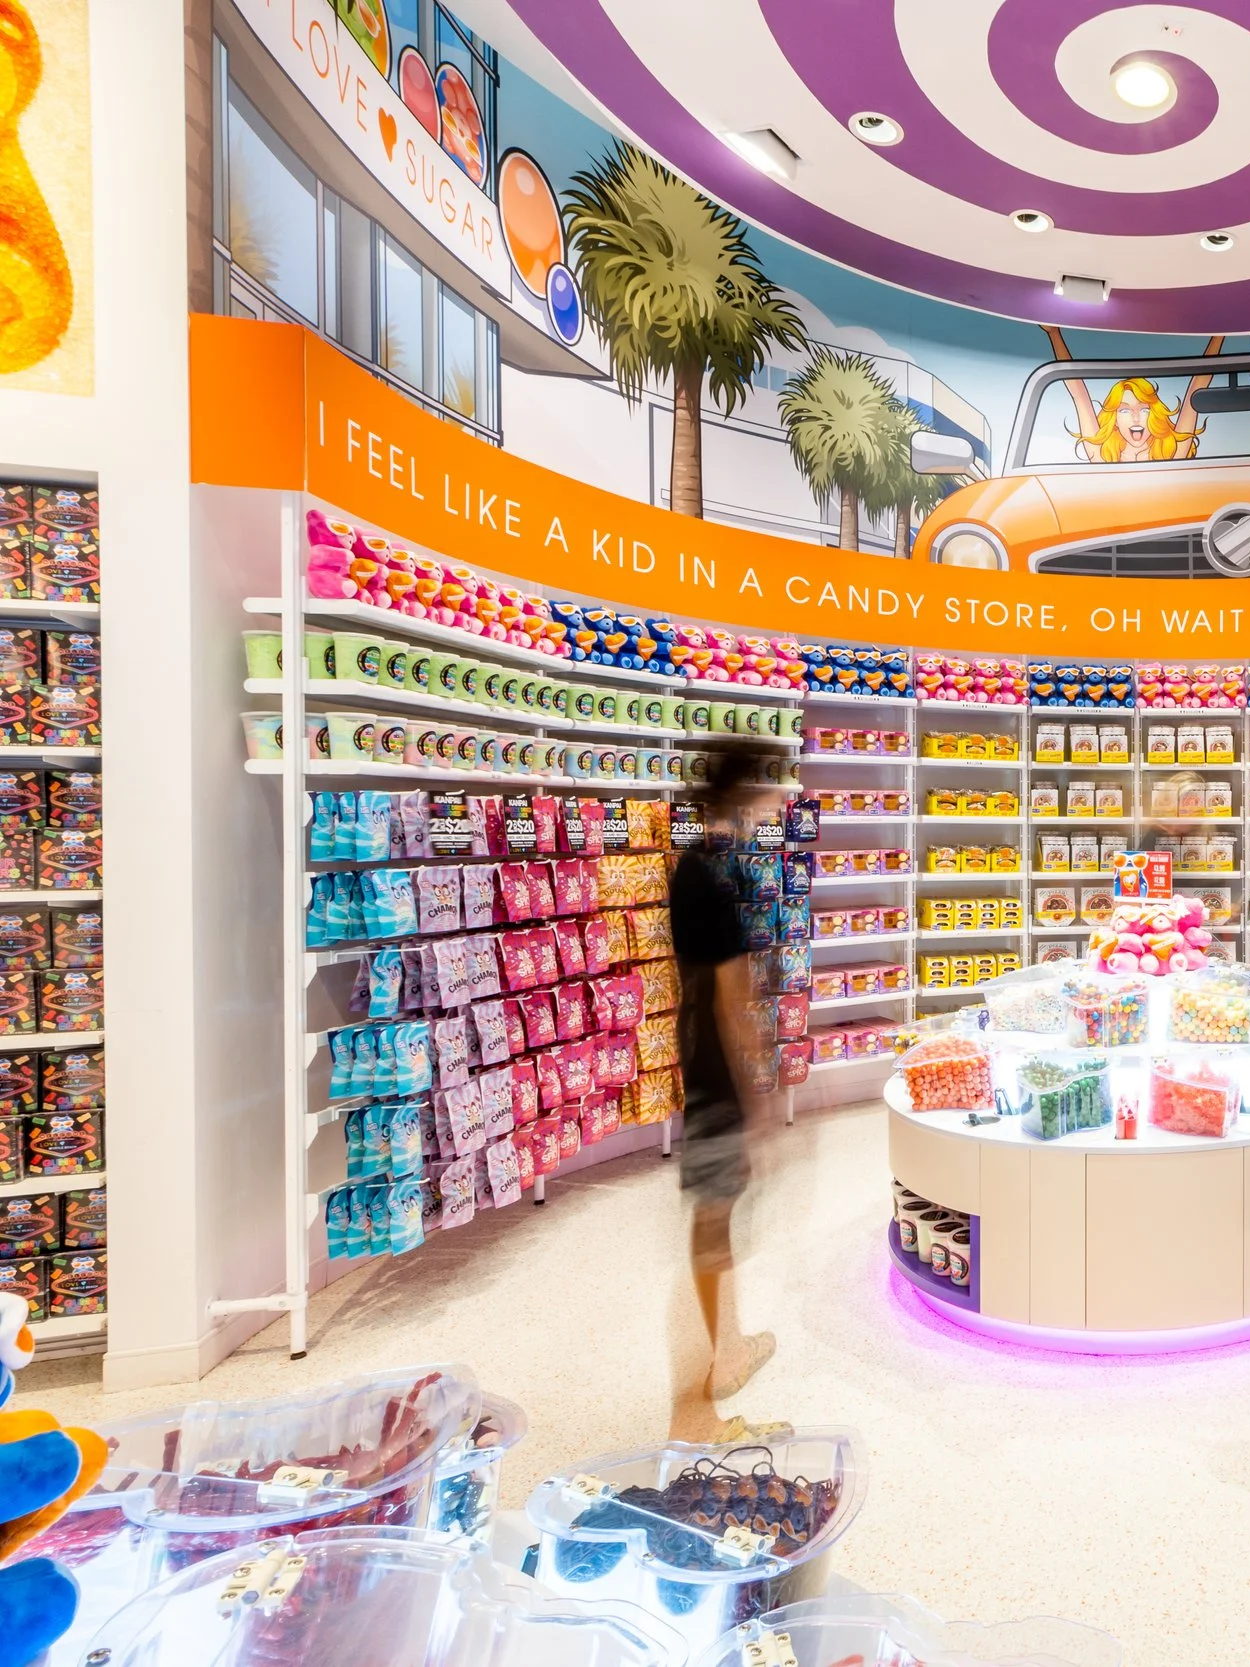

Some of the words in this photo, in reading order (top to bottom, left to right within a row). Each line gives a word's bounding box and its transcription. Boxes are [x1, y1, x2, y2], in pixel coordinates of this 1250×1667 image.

[291, 0, 367, 132] LOVE
[405, 139, 494, 261] SUGAR
[319, 400, 324, 446] I
[347, 418, 425, 500] FEEL
[444, 473, 521, 538] LIKE
[544, 516, 569, 553] A
[592, 528, 656, 574] KID
[679, 552, 716, 589] IN
[738, 567, 764, 598] A
[785, 575, 926, 620] CANDY
[945, 596, 1068, 633] STORE,
[1090, 606, 1142, 633] OH
[1161, 608, 1244, 634] WAIT
[683, 822, 704, 834] $20
[615, 1008, 638, 1020] SPICY
[565, 1076, 590, 1089] SPICY
